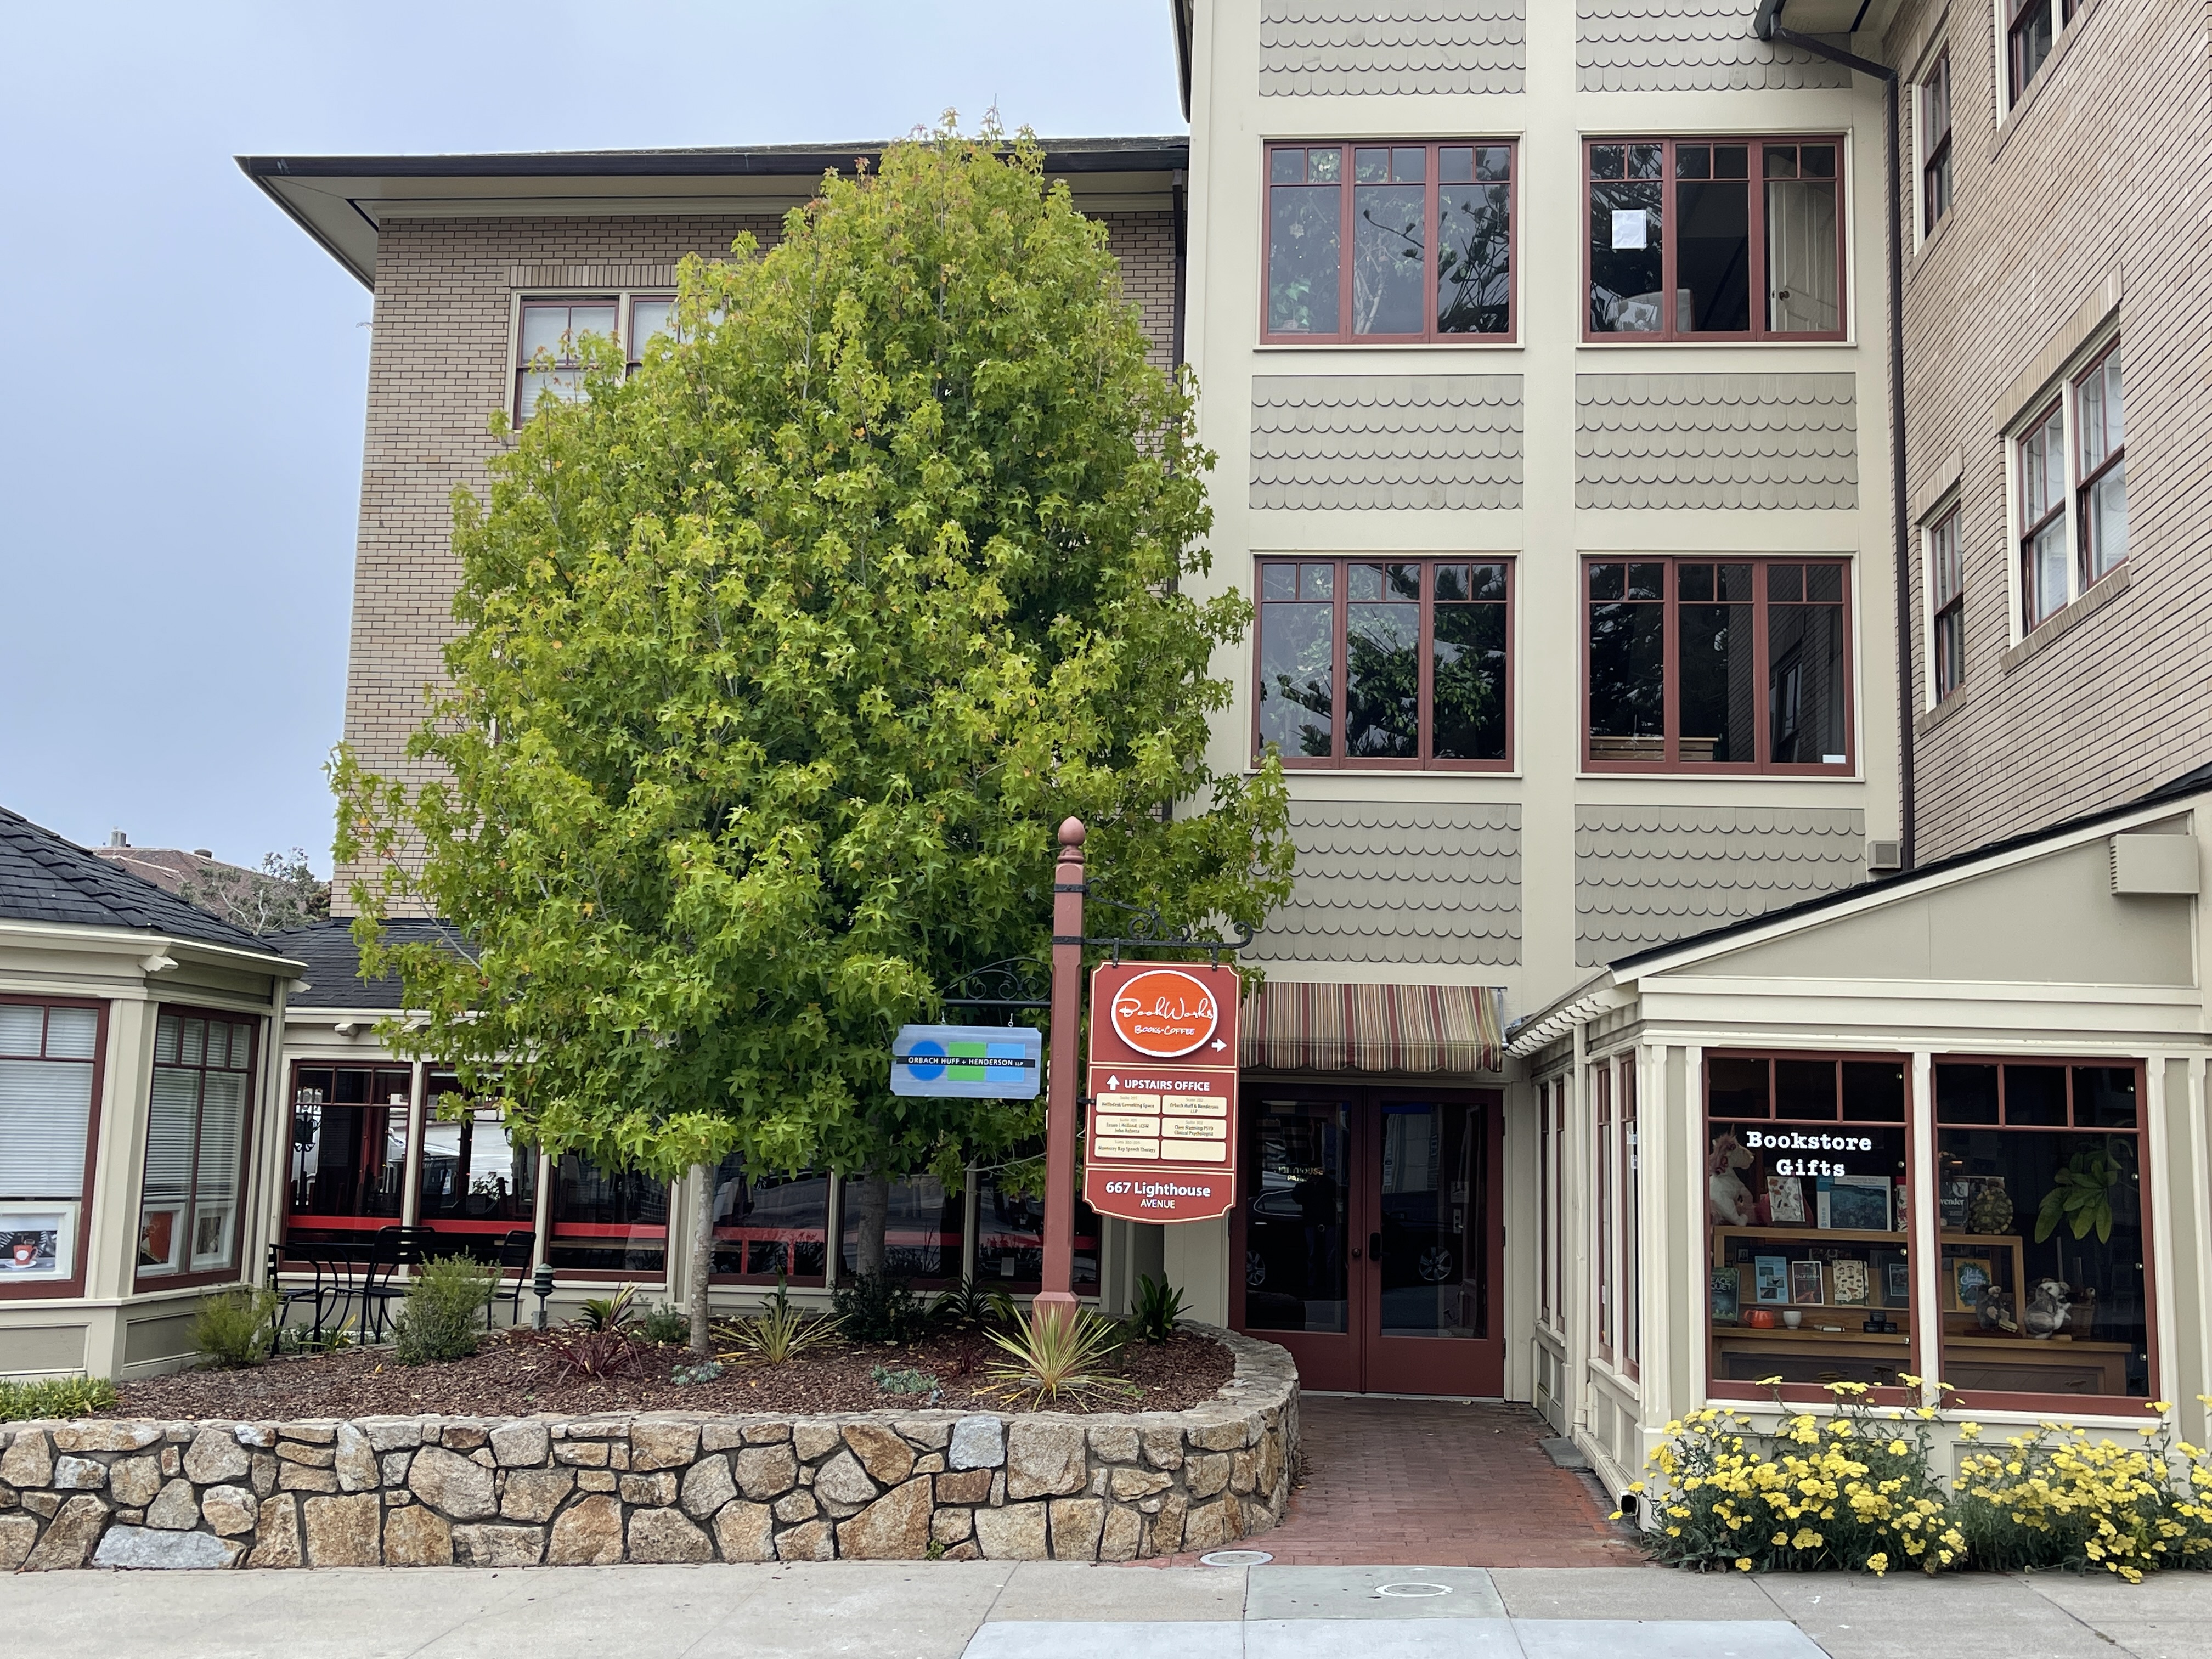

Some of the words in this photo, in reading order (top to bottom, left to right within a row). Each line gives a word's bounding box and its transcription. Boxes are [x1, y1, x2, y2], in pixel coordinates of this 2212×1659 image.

[1124, 1079, 1172, 1090] UPSTAIRS
[1174, 1081, 1210, 1091] OFFICE
[1746, 1131, 1872, 1151] Bookstore
[1776, 1159, 1846, 1177] Gifts
[1105, 1181, 1132, 1194] 667
[1134, 1181, 1211, 1198] Lighthouse
[1140, 1199, 1176, 1209] AVENUE
